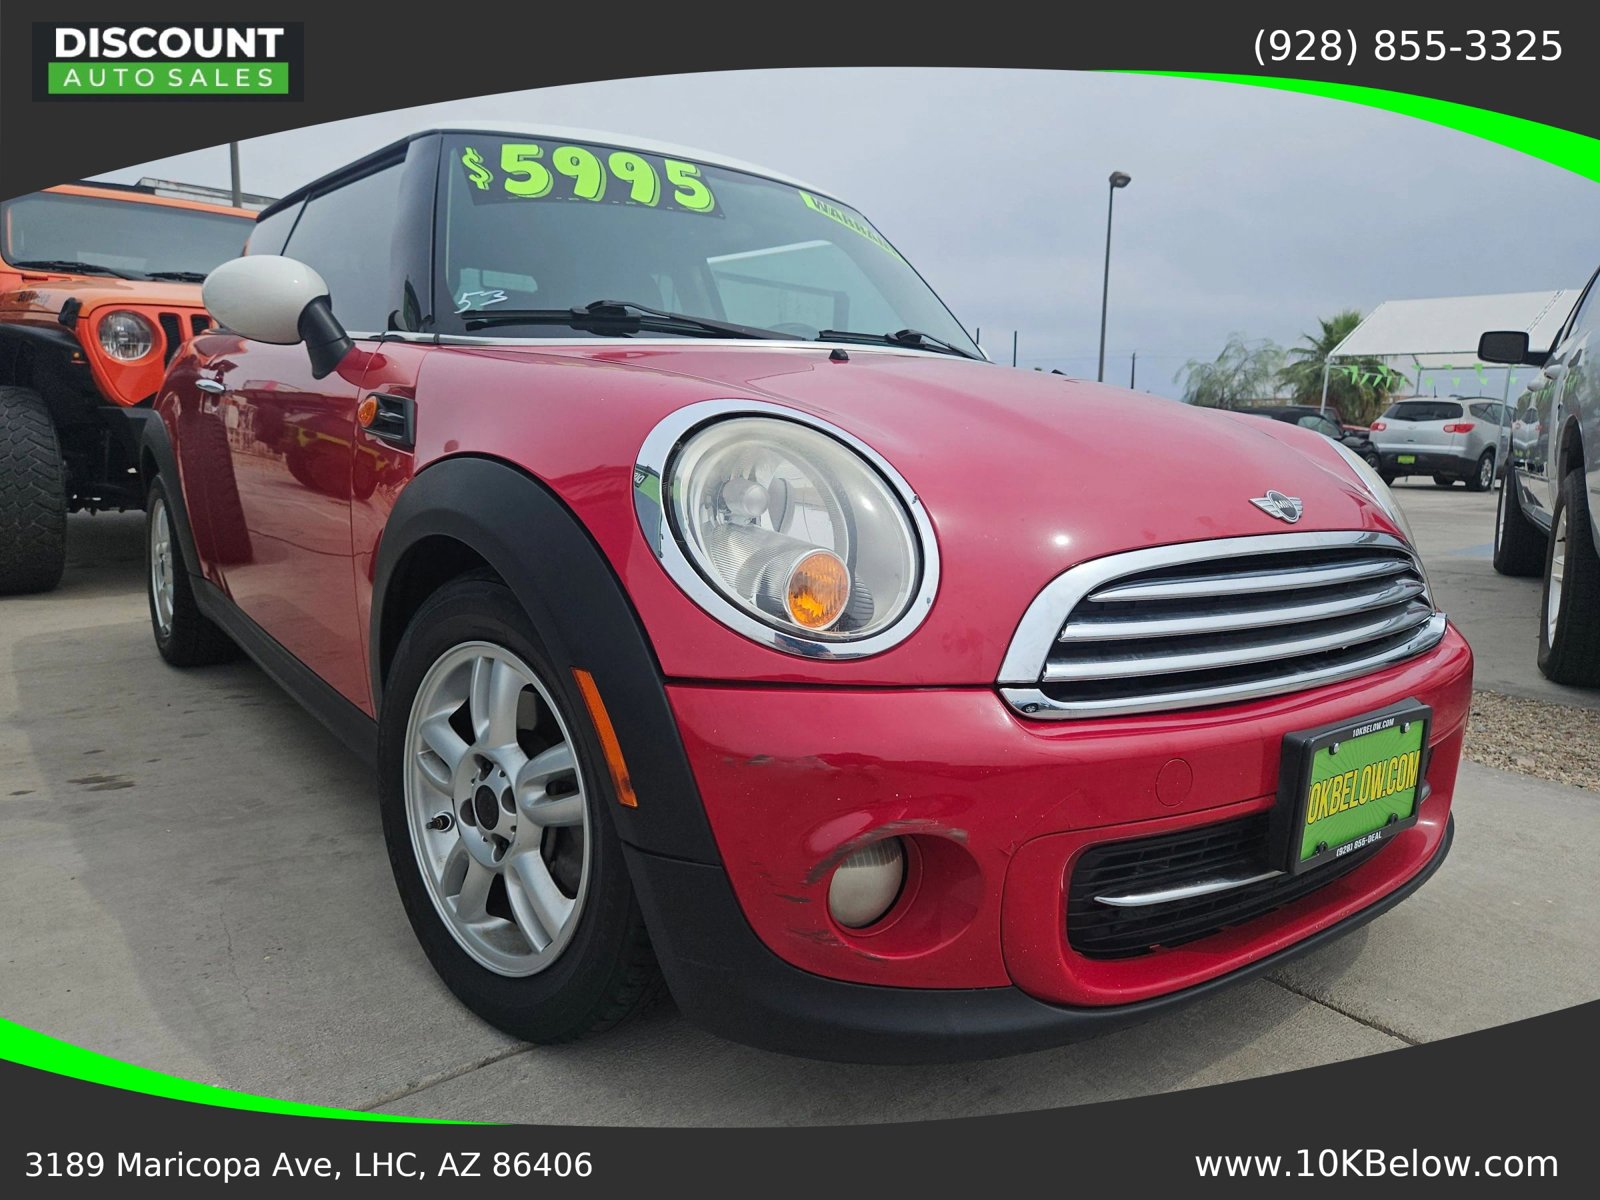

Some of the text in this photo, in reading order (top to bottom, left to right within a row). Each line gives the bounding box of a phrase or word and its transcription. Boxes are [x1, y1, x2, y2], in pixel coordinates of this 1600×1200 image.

[461, 143, 715, 213] $5995
[1352, 717, 1395, 738] 10KBELOW.COM
[1306, 750, 1421, 825] 0KBELOW.COM
